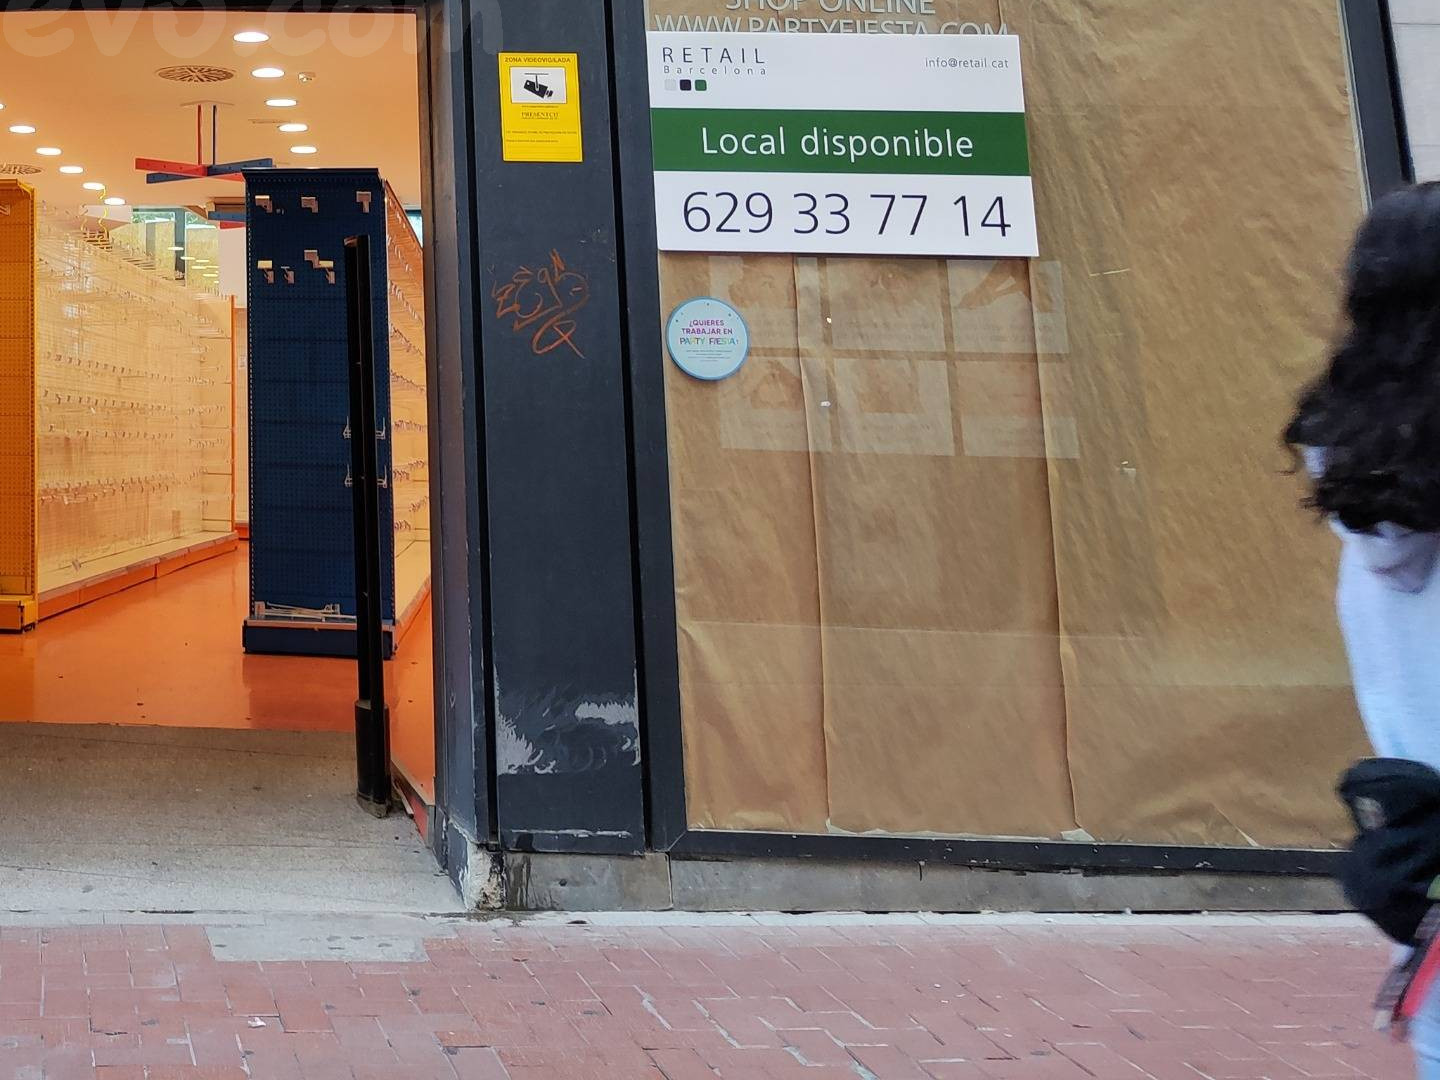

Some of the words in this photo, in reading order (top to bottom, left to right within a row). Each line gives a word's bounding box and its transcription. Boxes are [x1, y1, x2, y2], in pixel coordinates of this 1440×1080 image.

[662, 47, 765, 63] RETAIL
[663, 65, 766, 75] Barcelona
[702, 127, 785, 155] Local
[801, 127, 973, 162] disponible
[683, 191, 772, 234] 629
[793, 192, 850, 235] 33
[869, 194, 928, 236] 77
[953, 195, 1011, 237] 14
[679, 337, 706, 345] PARTY
